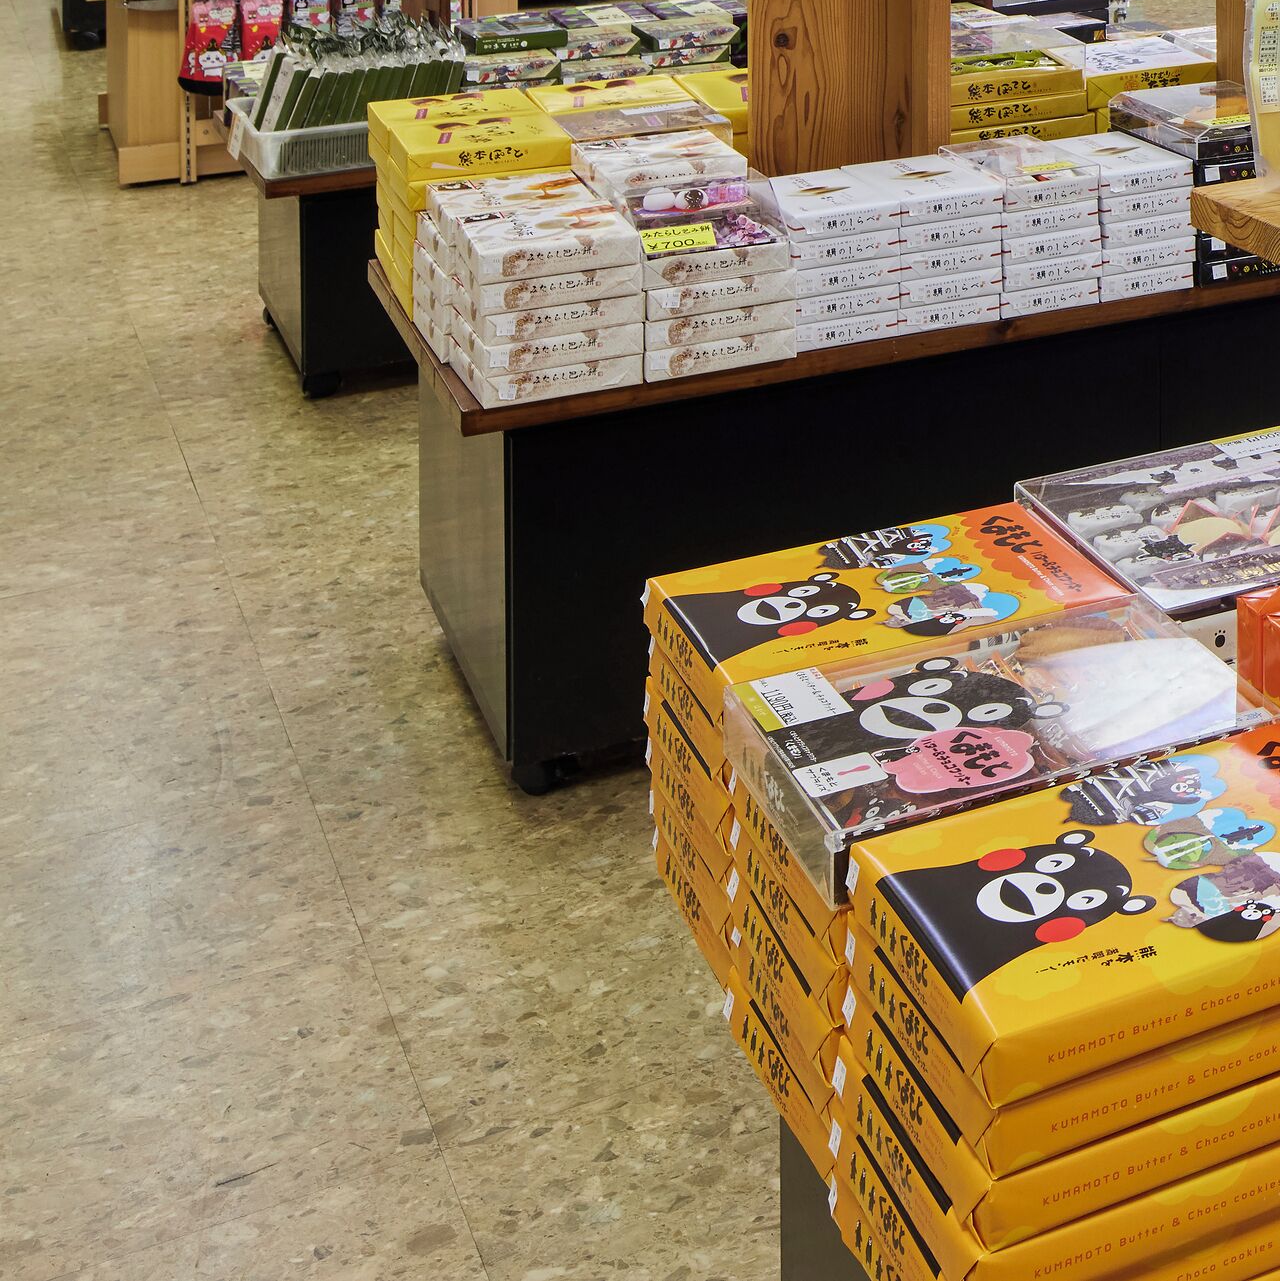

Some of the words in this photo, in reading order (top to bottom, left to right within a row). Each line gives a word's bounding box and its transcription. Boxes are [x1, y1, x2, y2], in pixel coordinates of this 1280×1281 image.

[967, 80, 1031, 101] 熊本ぽてと
[459, 147, 524, 166] 熊本ぽてと
[648, 238, 695, 250] ¥700
[980, 515, 1044, 554] くまもと
[950, 730, 1013, 778] くまもと
[1047, 1030, 1125, 1064] KUMAMOTO
[1132, 1013, 1178, 1036] Butter
[1185, 1007, 1194, 1017] &
[1200, 991, 1240, 1012] Choco
